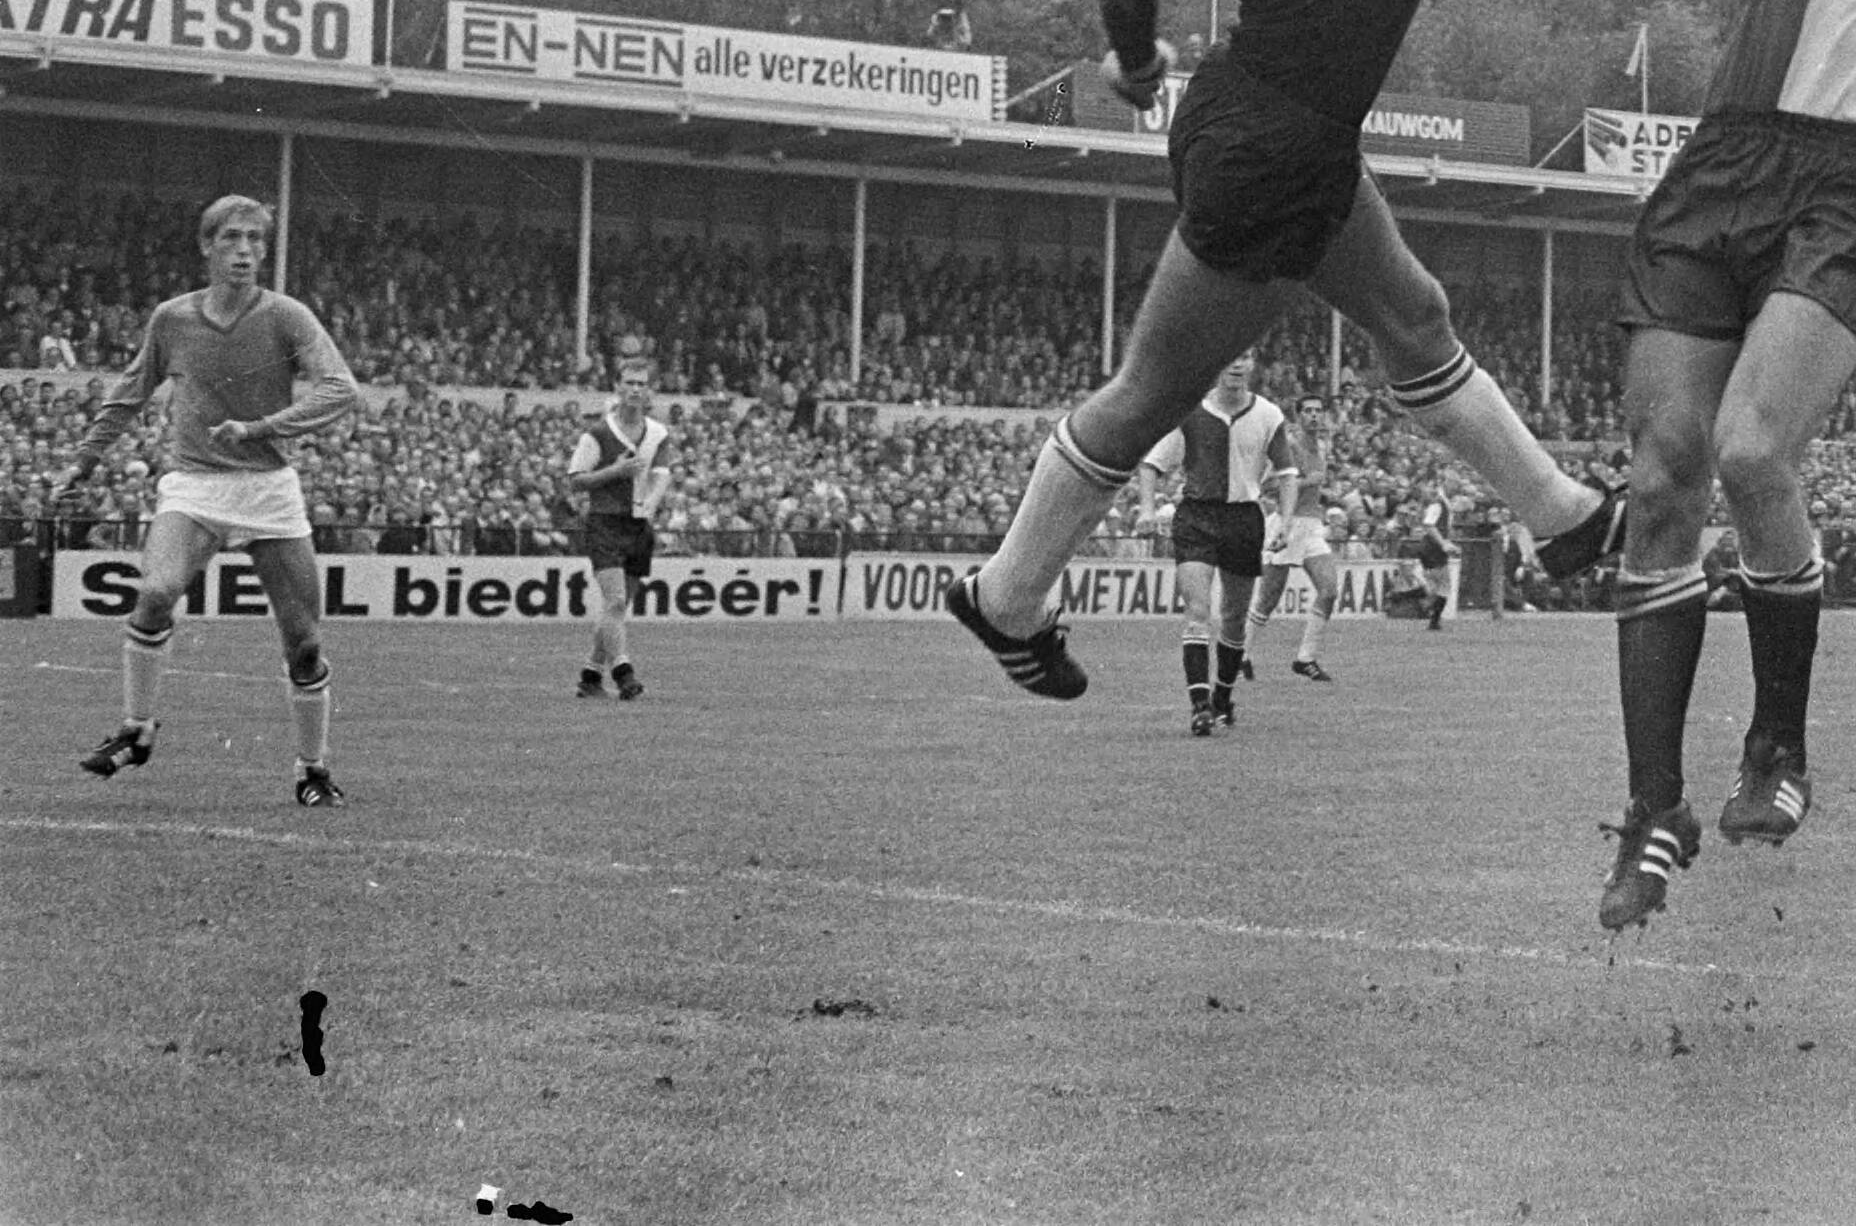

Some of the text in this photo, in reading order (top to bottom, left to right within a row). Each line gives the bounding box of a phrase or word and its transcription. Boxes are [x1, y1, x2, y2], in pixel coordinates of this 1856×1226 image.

[694, 38, 750, 78] alle
[760, 49, 980, 106] verzekeringen
[81, 561, 369, 616] SEL
[393, 568, 588, 616] biedt
[864, 563, 954, 610] VOOR
[1060, 568, 1187, 614] METALL
